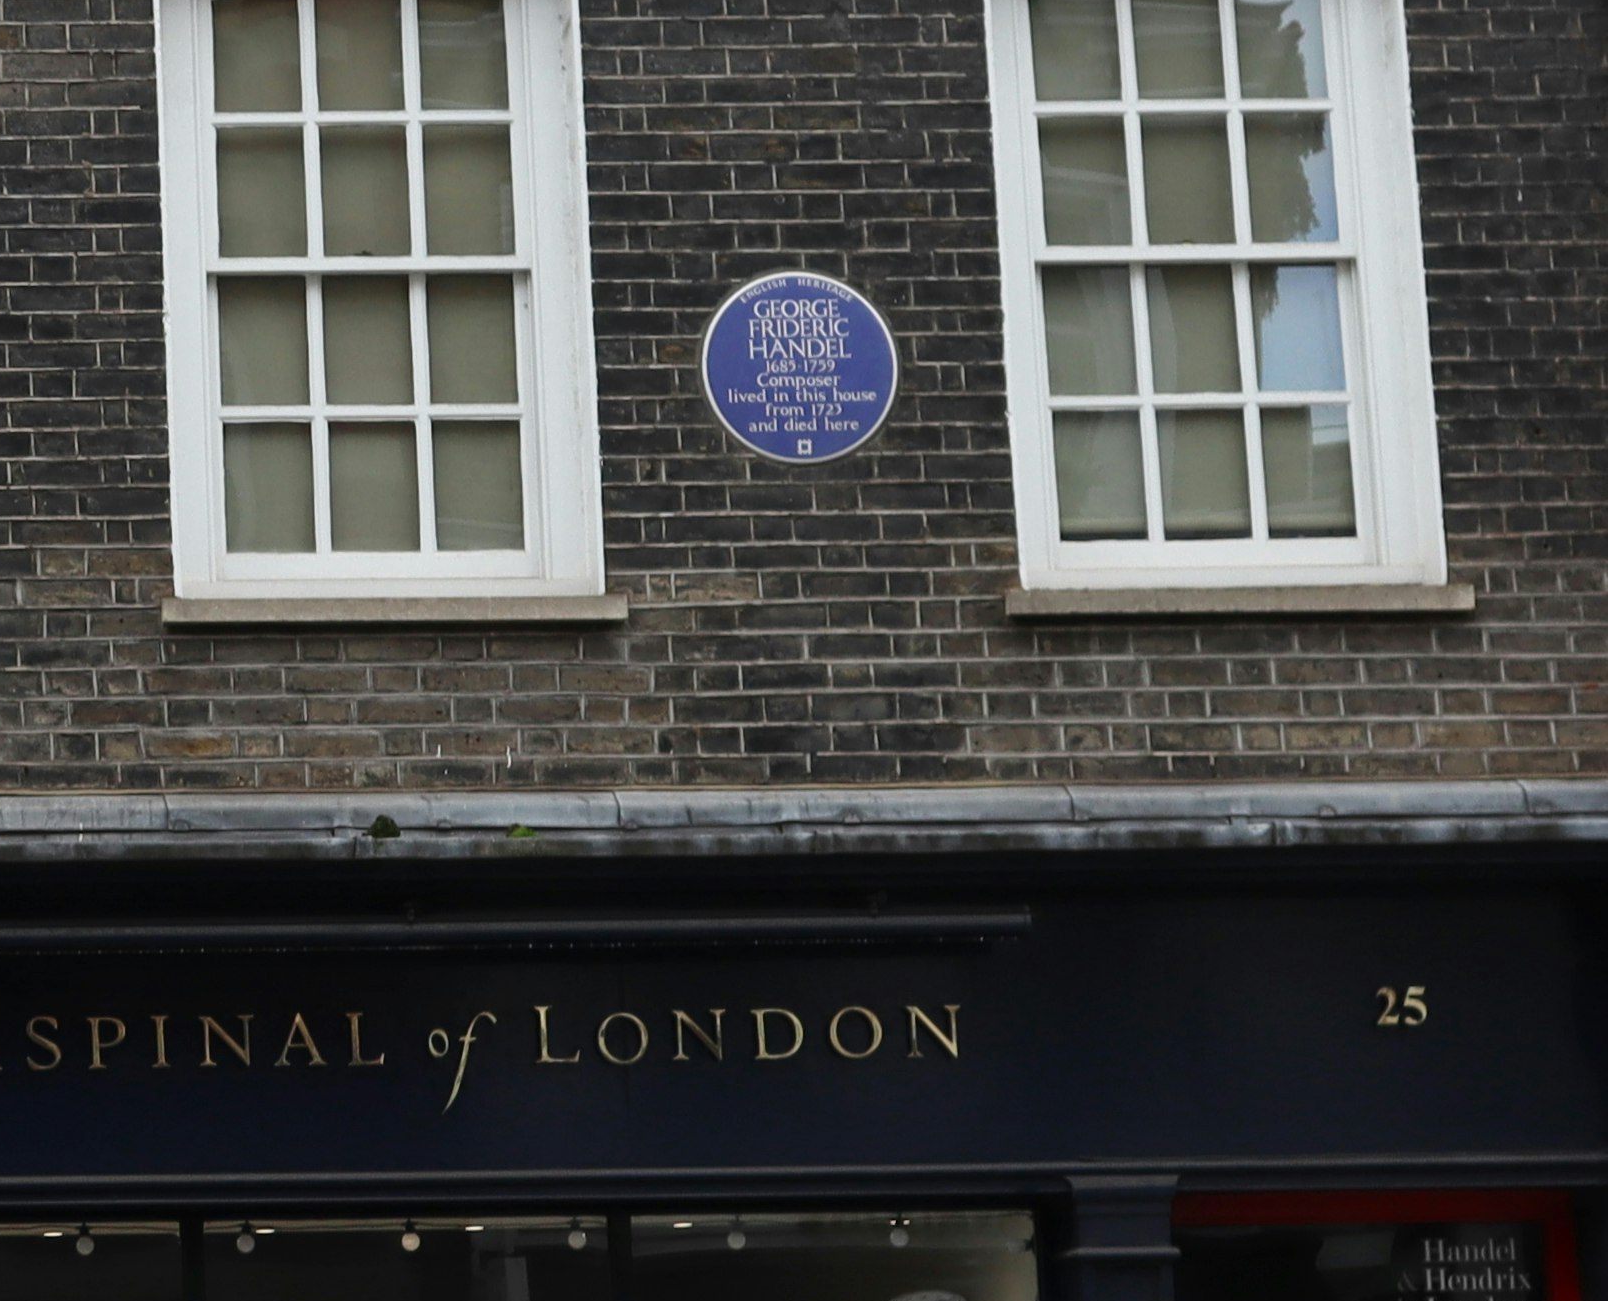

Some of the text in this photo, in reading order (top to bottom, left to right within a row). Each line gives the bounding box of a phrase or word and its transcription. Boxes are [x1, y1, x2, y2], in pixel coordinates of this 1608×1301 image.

[740, 278, 853, 304] ENGLISH HERITAGE
[753, 299, 840, 319] GEORGE
[748, 318, 850, 338] FRIDERIC
[748, 338, 852, 360] HANDEL
[756, 373, 841, 389] Composer
[728, 388, 877, 403] lived in this house
[765, 402, 842, 417] from 1723
[749, 417, 859, 432] and died here
[1375, 986, 1428, 1026] 25
[427, 1011, 498, 1116] of
[533, 1004, 963, 1065] LONDON
[1422, 1237, 1517, 1263] Handel
[1396, 1267, 1532, 1292] & Hendrix
